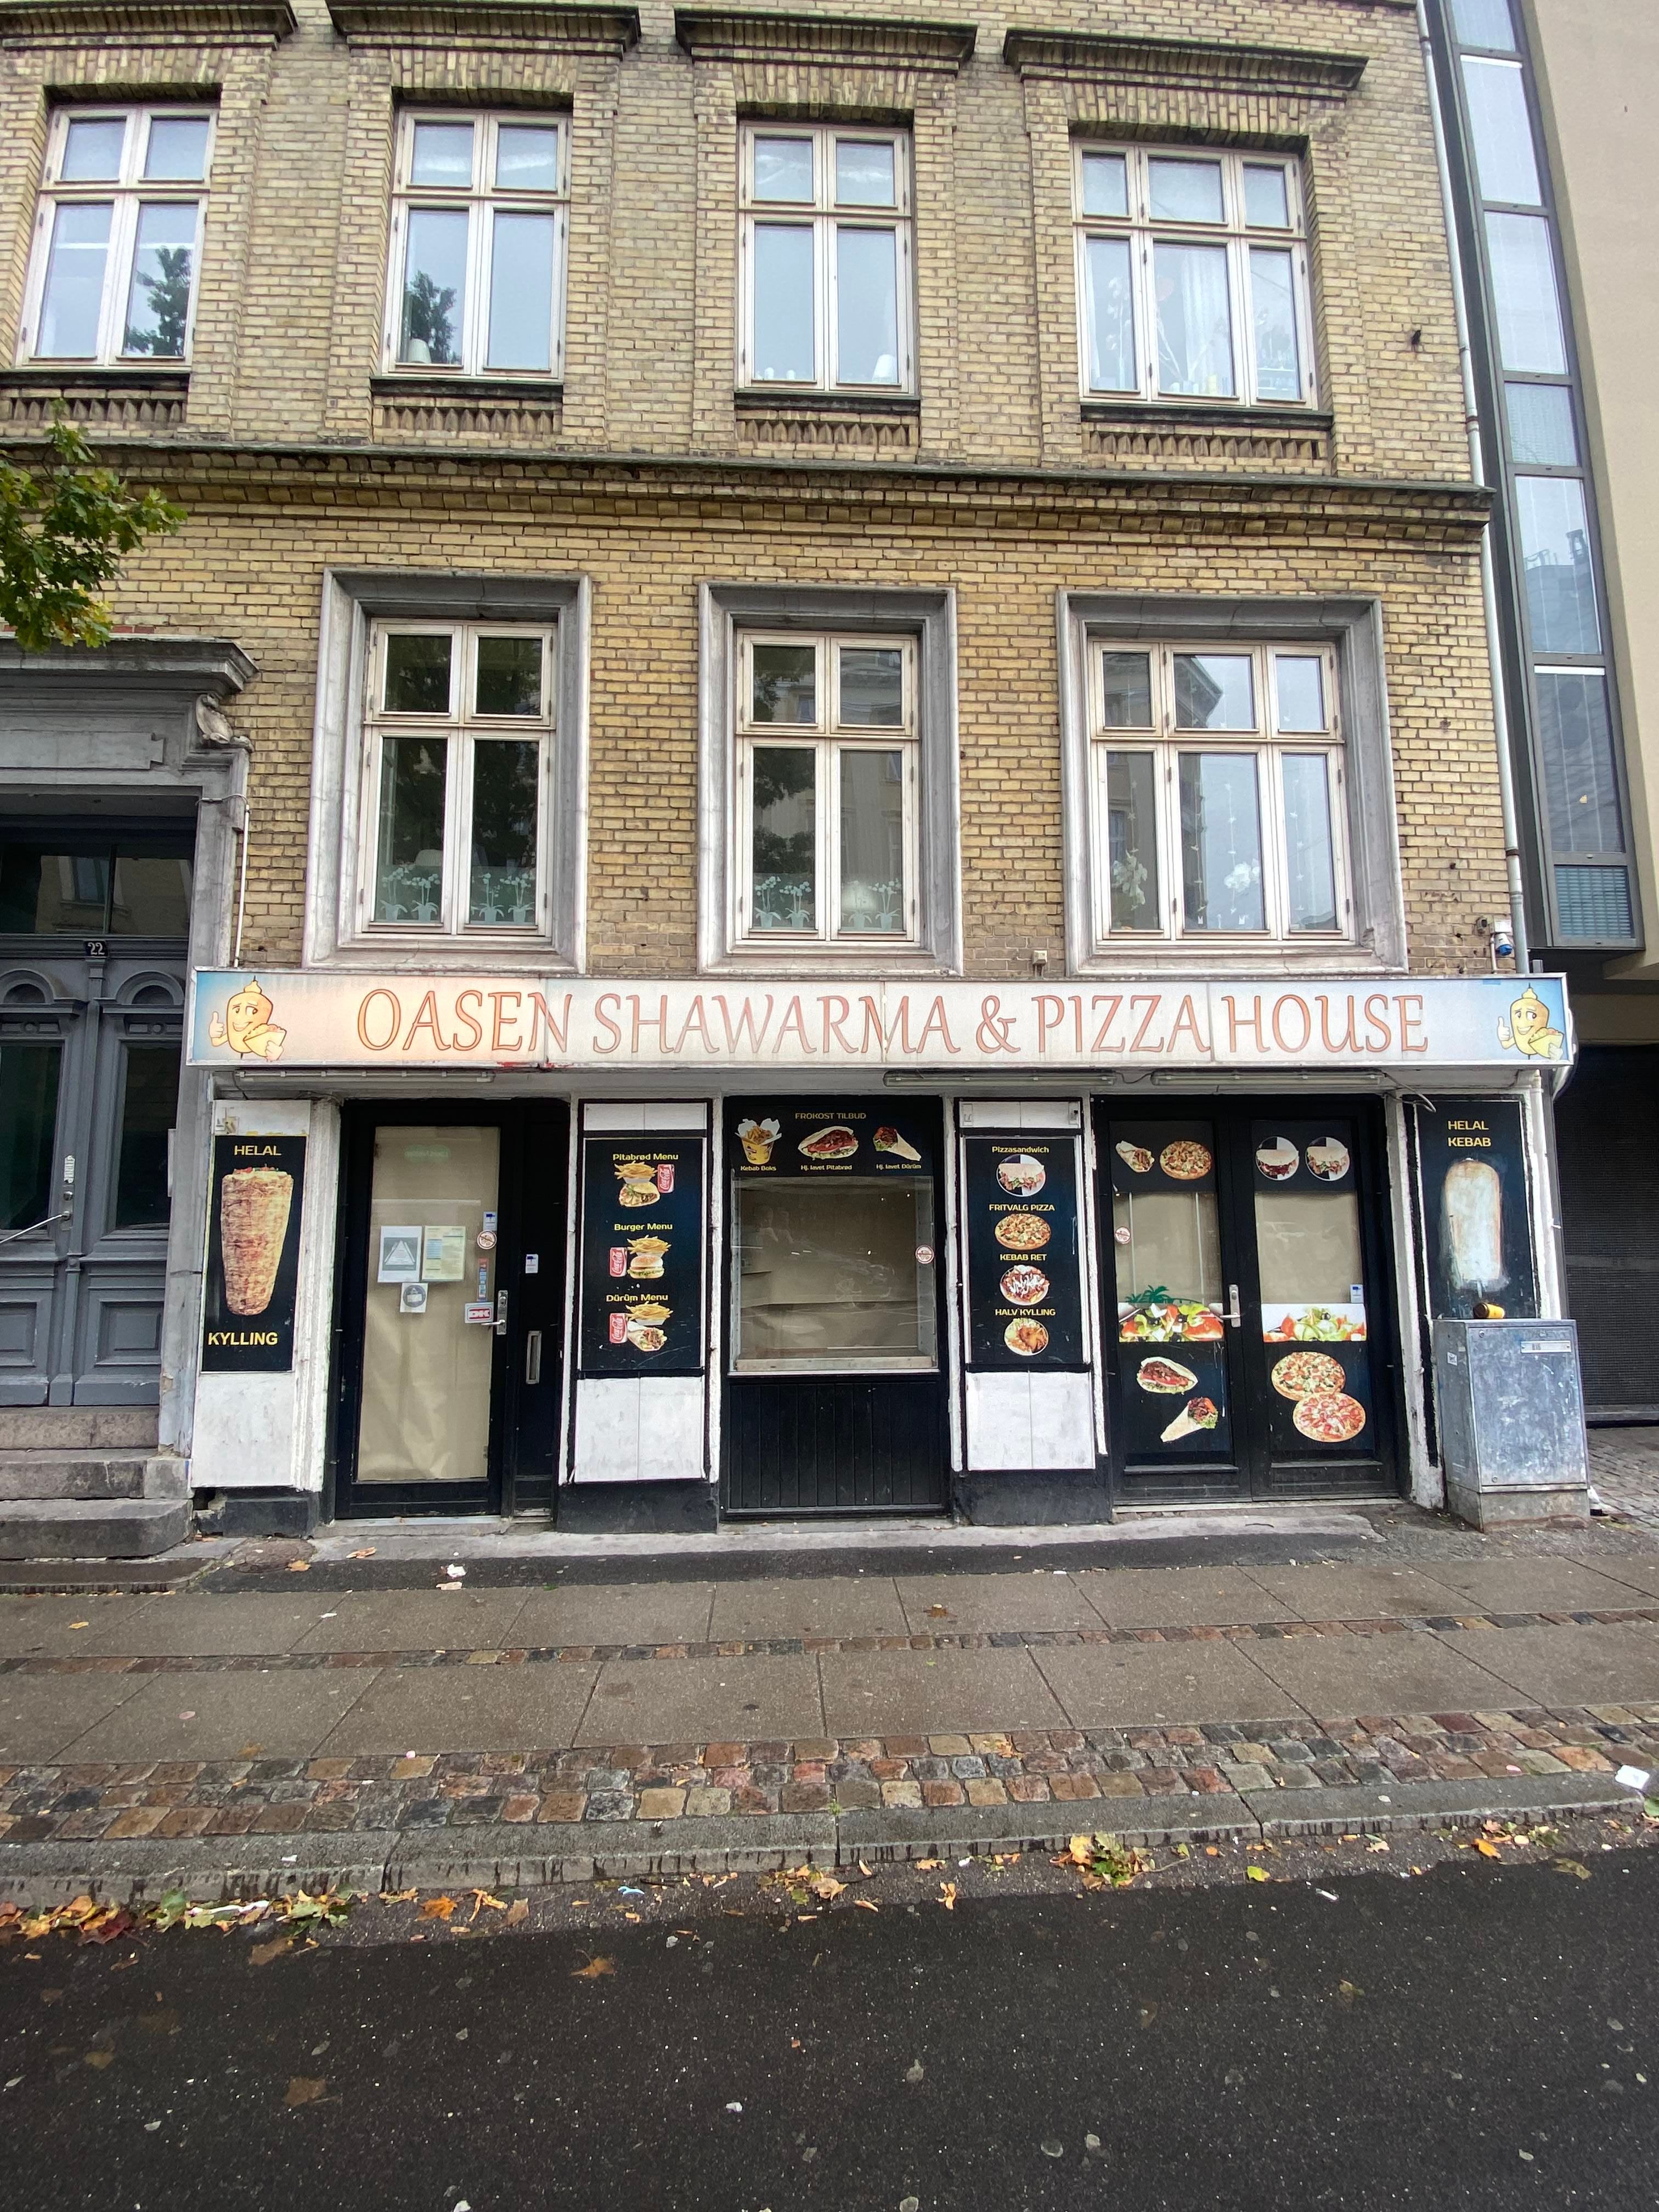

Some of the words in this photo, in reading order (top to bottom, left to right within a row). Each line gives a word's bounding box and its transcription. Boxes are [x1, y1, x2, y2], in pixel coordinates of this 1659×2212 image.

[88, 942, 105, 955] 22
[358, 988, 570, 1053] OASEN
[593, 994, 961, 1056] SHAWARMA
[976, 995, 1022, 1053] &
[1031, 995, 1211, 1054] PIZZA
[1221, 995, 1429, 1054] HOUSE
[1448, 1120, 1489, 1130] HELAL
[1448, 1137, 1492, 1147] KEBAB
[234, 1145, 282, 1156] HELAL
[207, 1331, 279, 1346] KYLLING
